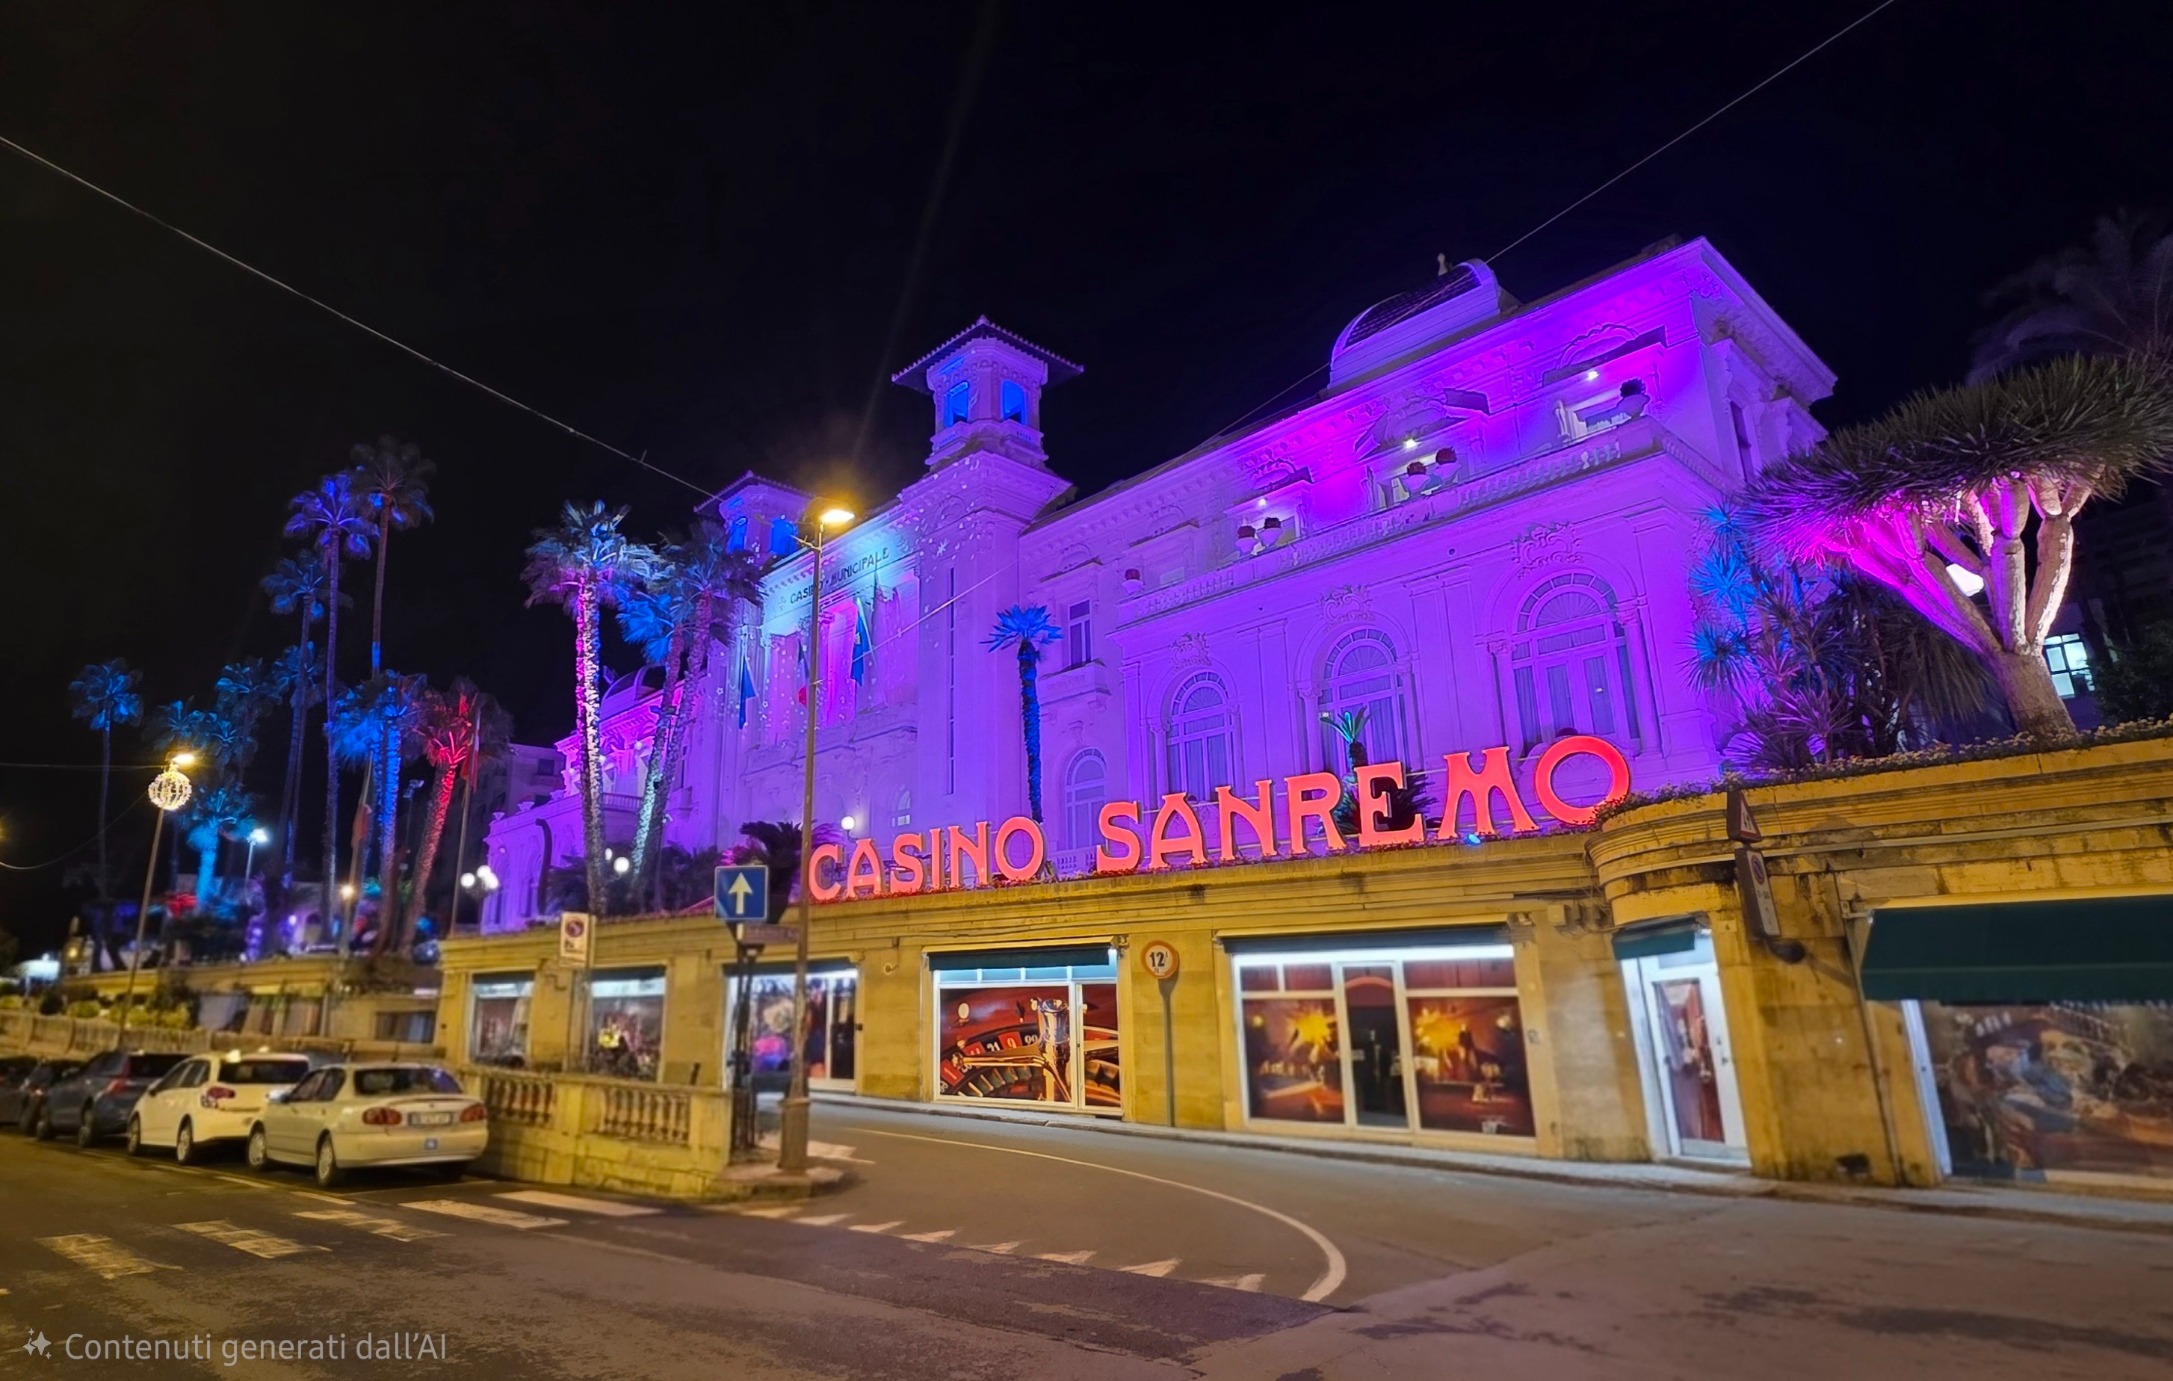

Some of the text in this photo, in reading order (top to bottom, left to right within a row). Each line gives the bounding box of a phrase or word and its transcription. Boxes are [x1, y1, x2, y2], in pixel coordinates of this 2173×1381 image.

[790, 547, 889, 604] CASIO MUNICIPALE
[809, 735, 1631, 900] CASINO SANREMO
